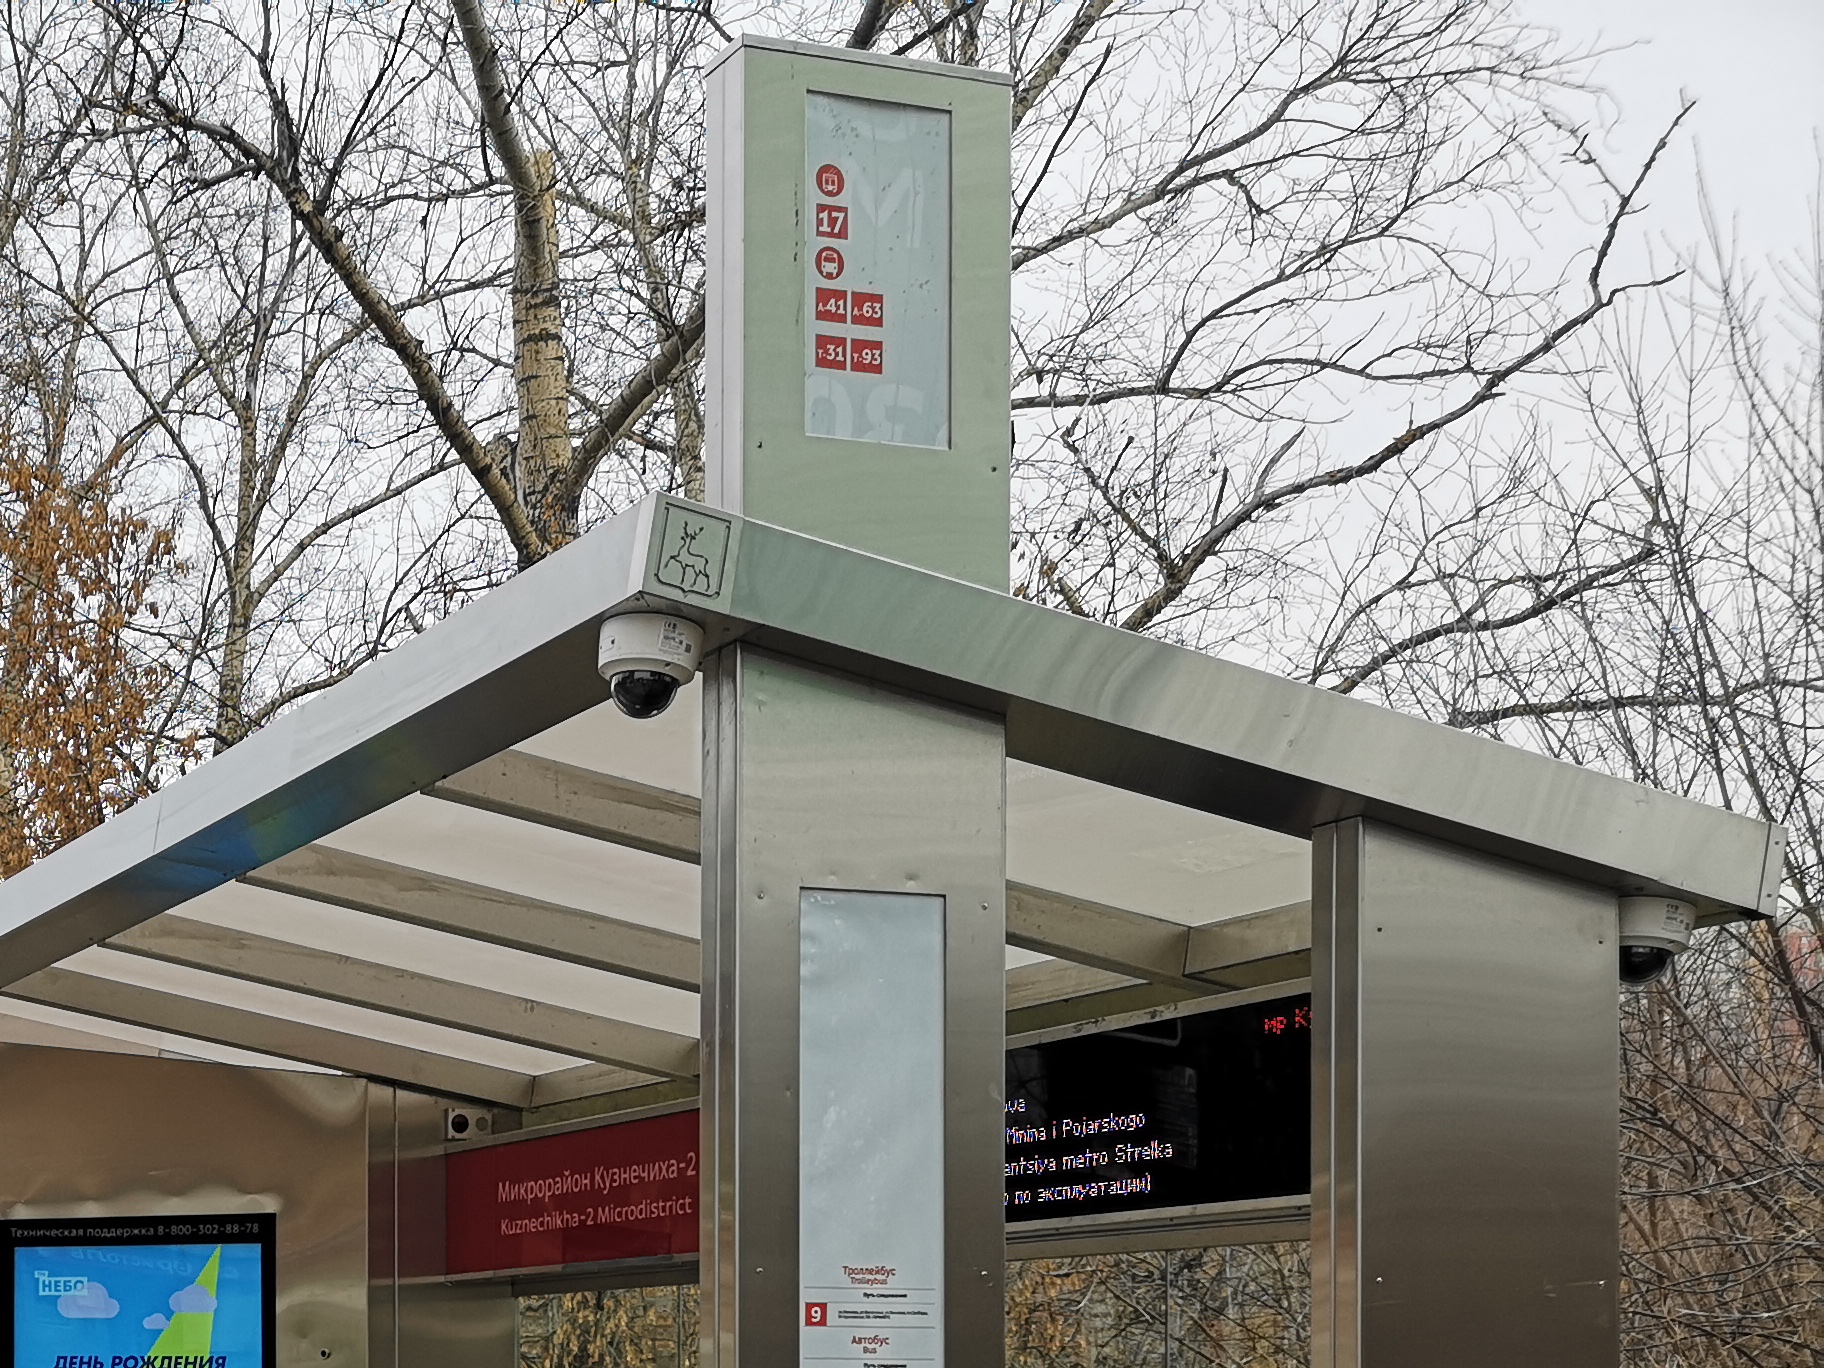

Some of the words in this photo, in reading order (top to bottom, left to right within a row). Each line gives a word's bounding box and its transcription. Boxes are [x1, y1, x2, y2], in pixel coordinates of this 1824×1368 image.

[817, 210, 846, 235] 17
[1062, 1112, 1146, 1138] Pojarskogo
[1062, 1148, 1109, 1170] metro
[1114, 1139, 1174, 1163] Strelka
[497, 1169, 591, 1205] Микрорайон
[594, 1151, 696, 1195] Кузнечиха-2
[500, 1207, 595, 1236] Kuznechikha-2
[597, 1196, 693, 1225] Microdistrict
[11, 1227, 84, 1238] Техническая
[86, 1226, 154, 1239] поддержка
[157, 1223, 260, 1236] 8-800-302-88-78
[842, 1266, 896, 1278] Троллейбус
[41, 1279, 85, 1293] НЕБО
[811, 1306, 822, 1322] 9
[851, 1335, 890, 1347] Автобус
[863, 1346, 877, 1354] Bus
